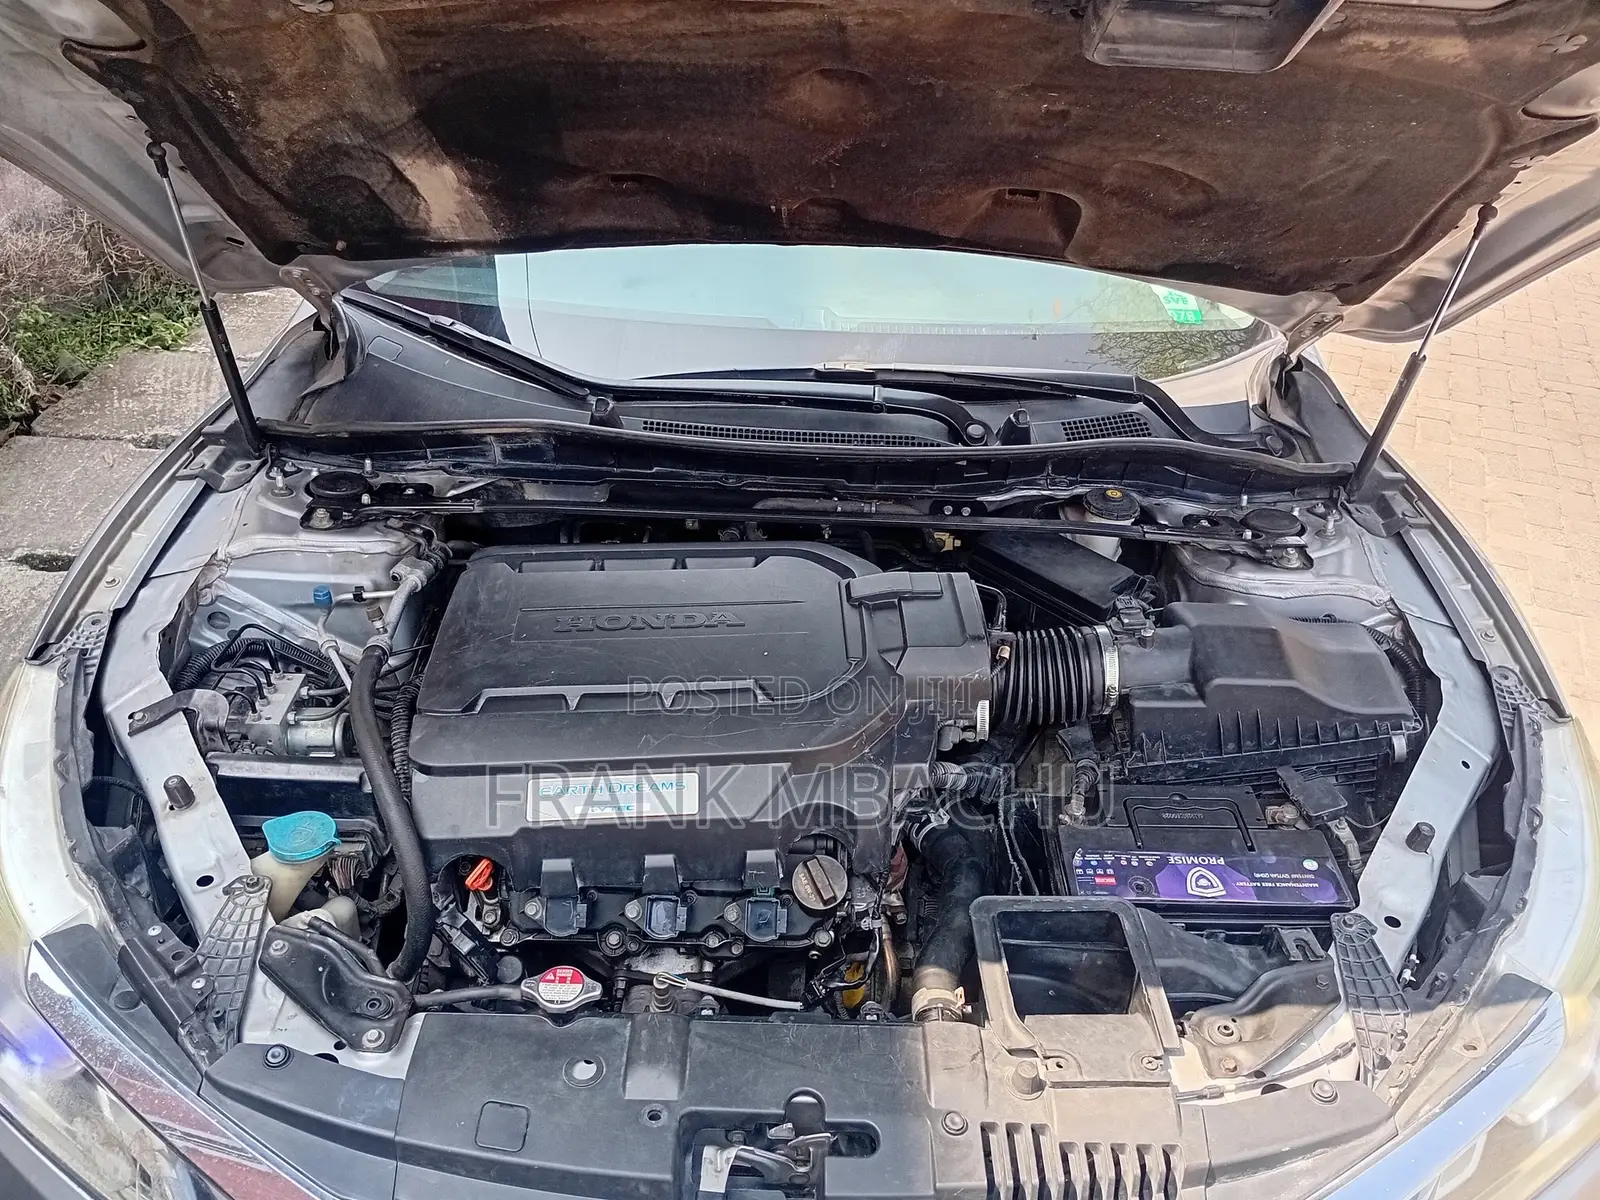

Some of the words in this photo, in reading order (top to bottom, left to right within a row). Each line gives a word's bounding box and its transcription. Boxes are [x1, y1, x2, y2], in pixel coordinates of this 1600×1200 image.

[553, 611, 746, 633] HONDA
[539, 783, 604, 797] EARTH
[1168, 856, 1225, 865] PROMISE
